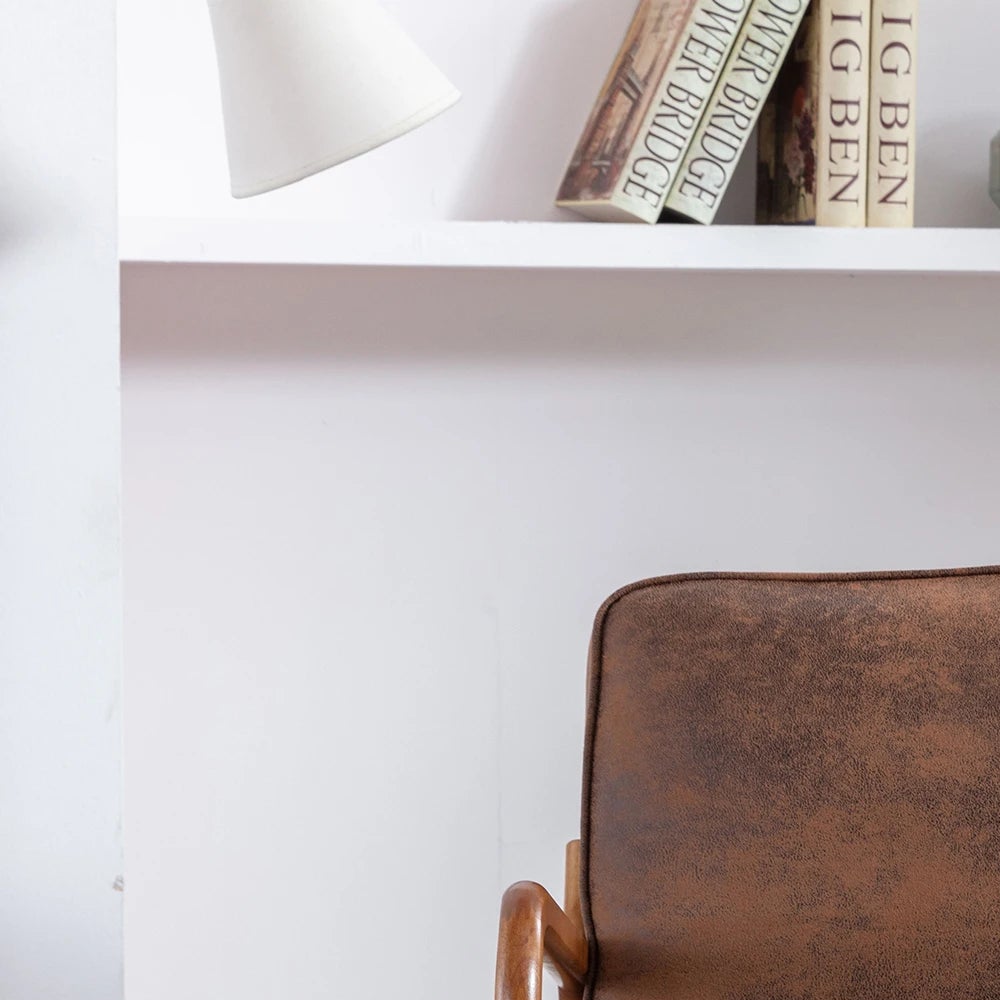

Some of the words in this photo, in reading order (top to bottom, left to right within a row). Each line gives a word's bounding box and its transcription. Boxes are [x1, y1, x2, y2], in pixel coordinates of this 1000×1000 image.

[829, 11, 862, 75] IG
[879, 12, 912, 78] IG
[622, 81, 704, 208] BRIDGE
[679, 83, 760, 208] BRIDGE
[828, 94, 861, 208] BEN
[877, 97, 910, 209] BEN
